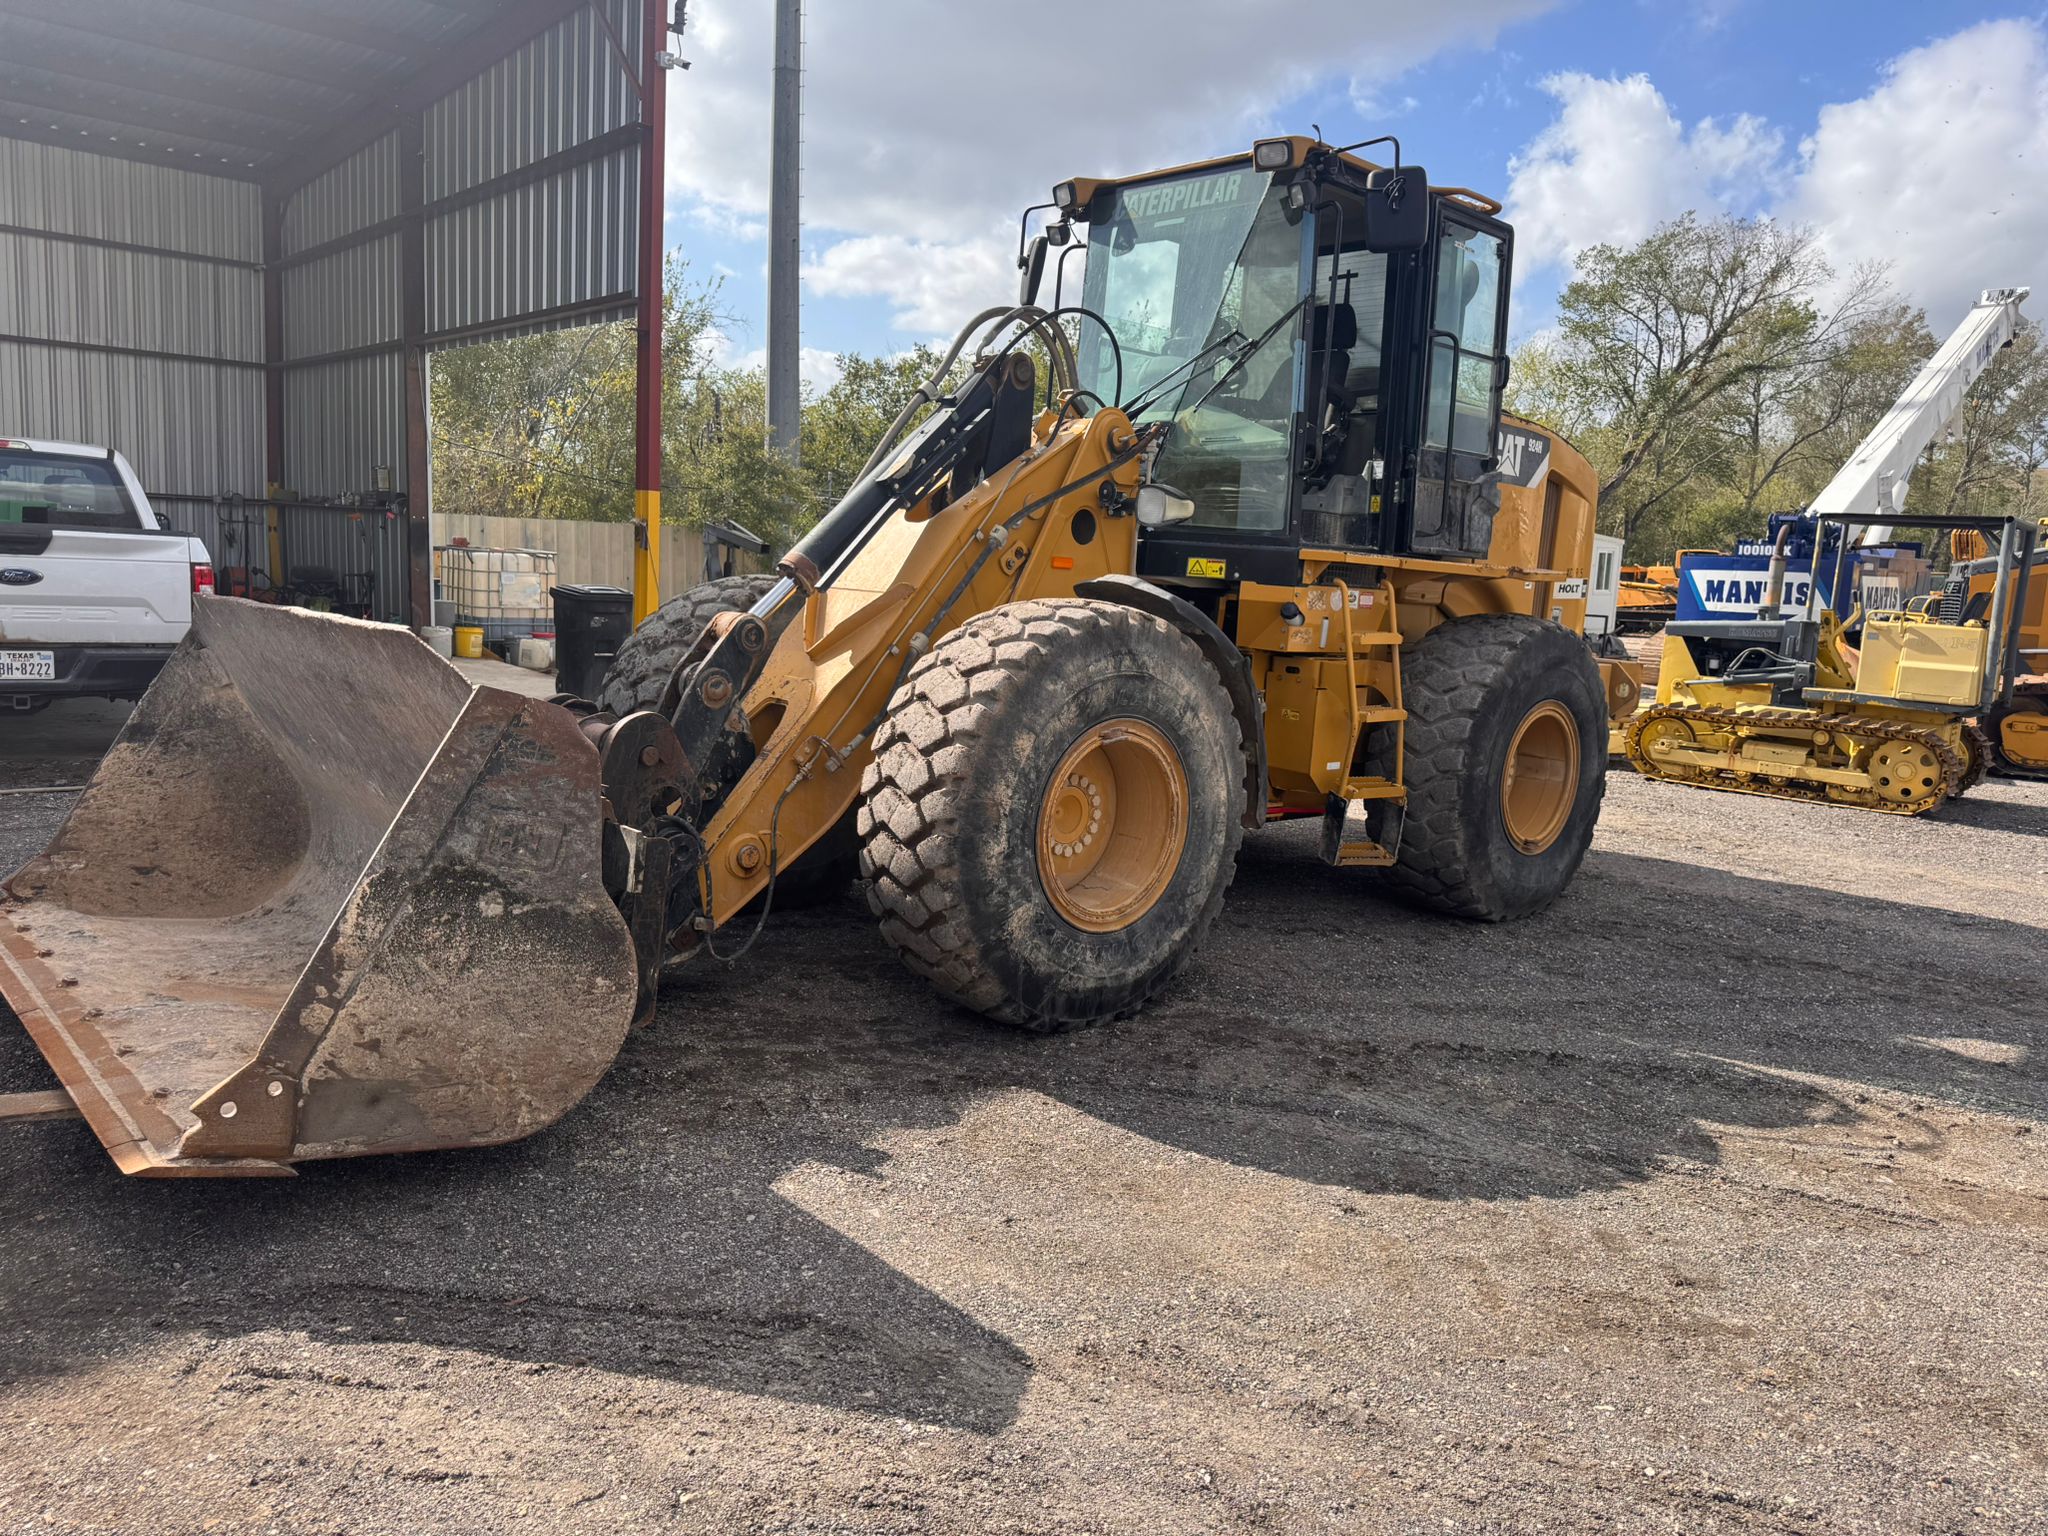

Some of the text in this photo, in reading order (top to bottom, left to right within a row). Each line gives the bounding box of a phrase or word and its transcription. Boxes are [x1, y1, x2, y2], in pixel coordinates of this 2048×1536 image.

[1, 570, 32, 582] Ford
[1558, 584, 1580, 594] HOLT
[1704, 579, 1810, 607] MANIS
[1866, 586, 1899, 610] MANTIS
